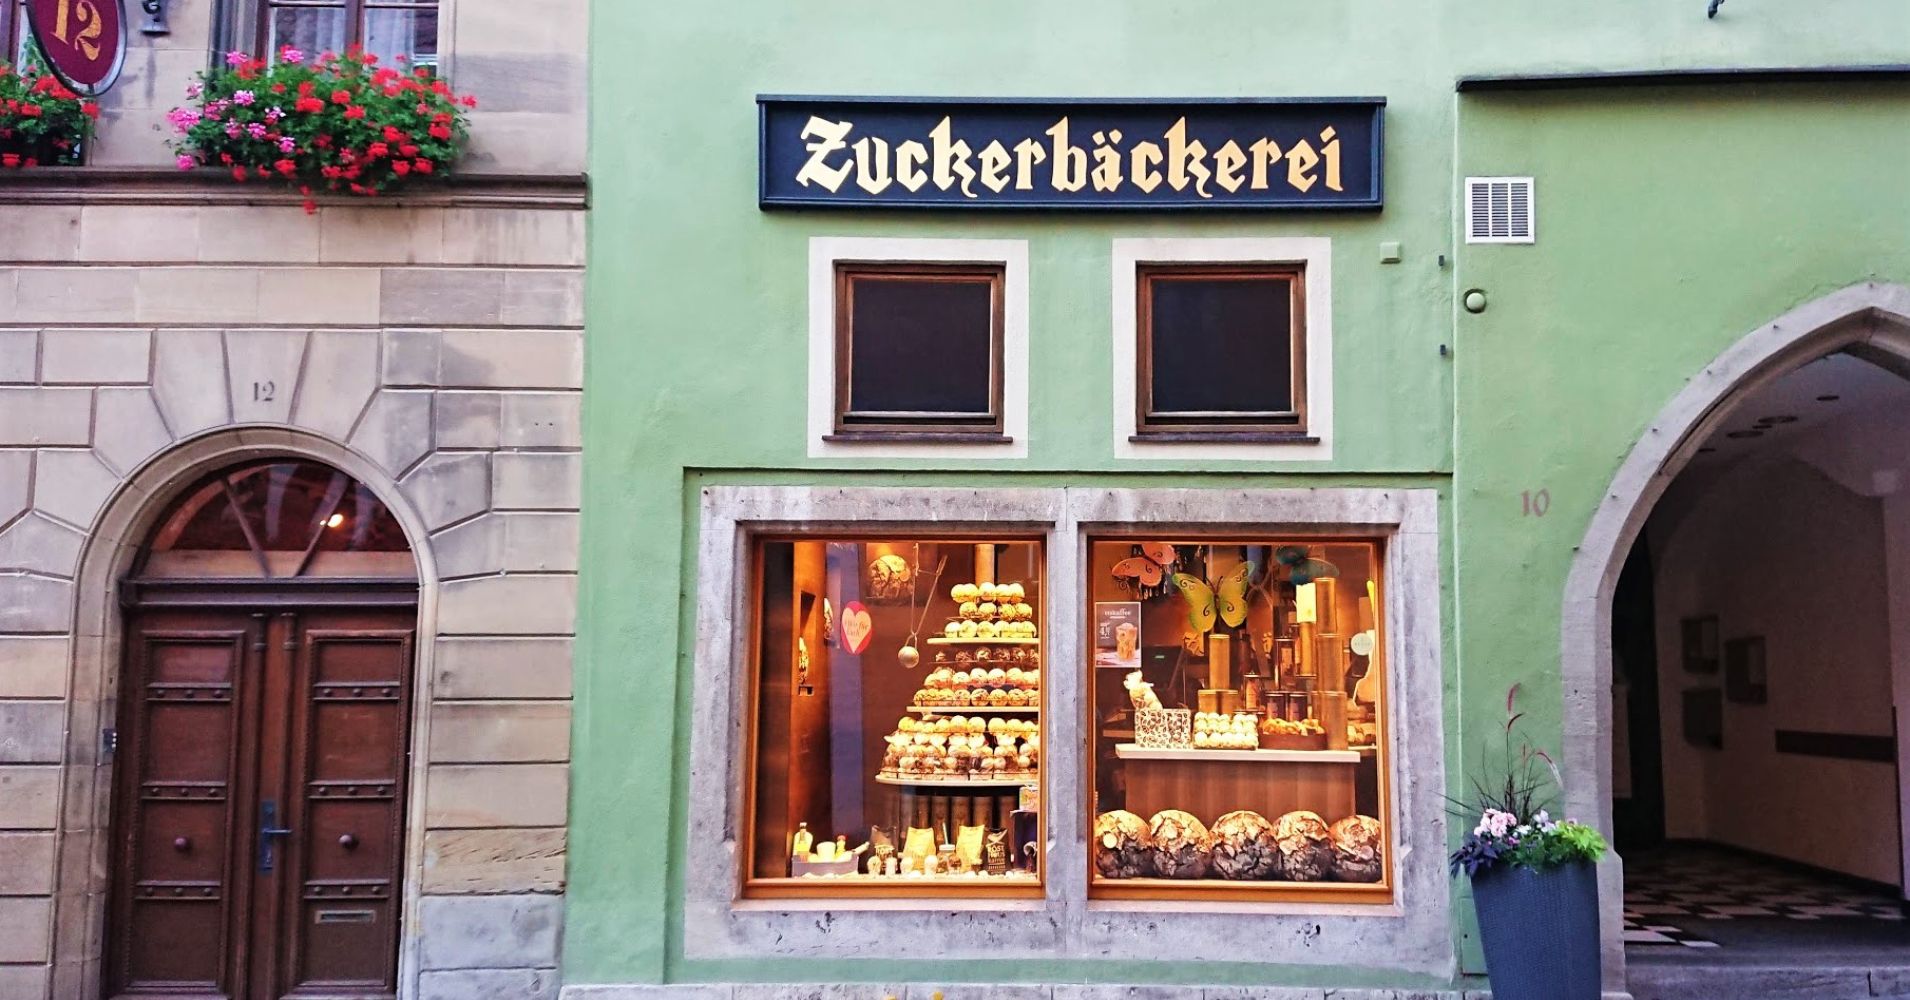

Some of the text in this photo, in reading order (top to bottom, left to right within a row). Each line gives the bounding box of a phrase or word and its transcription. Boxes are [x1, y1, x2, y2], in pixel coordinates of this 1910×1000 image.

[50, 0, 102, 61] 12
[796, 115, 1343, 198] Zuckerbäckerei
[253, 380, 275, 402] 12
[1520, 488, 1550, 517] 10
